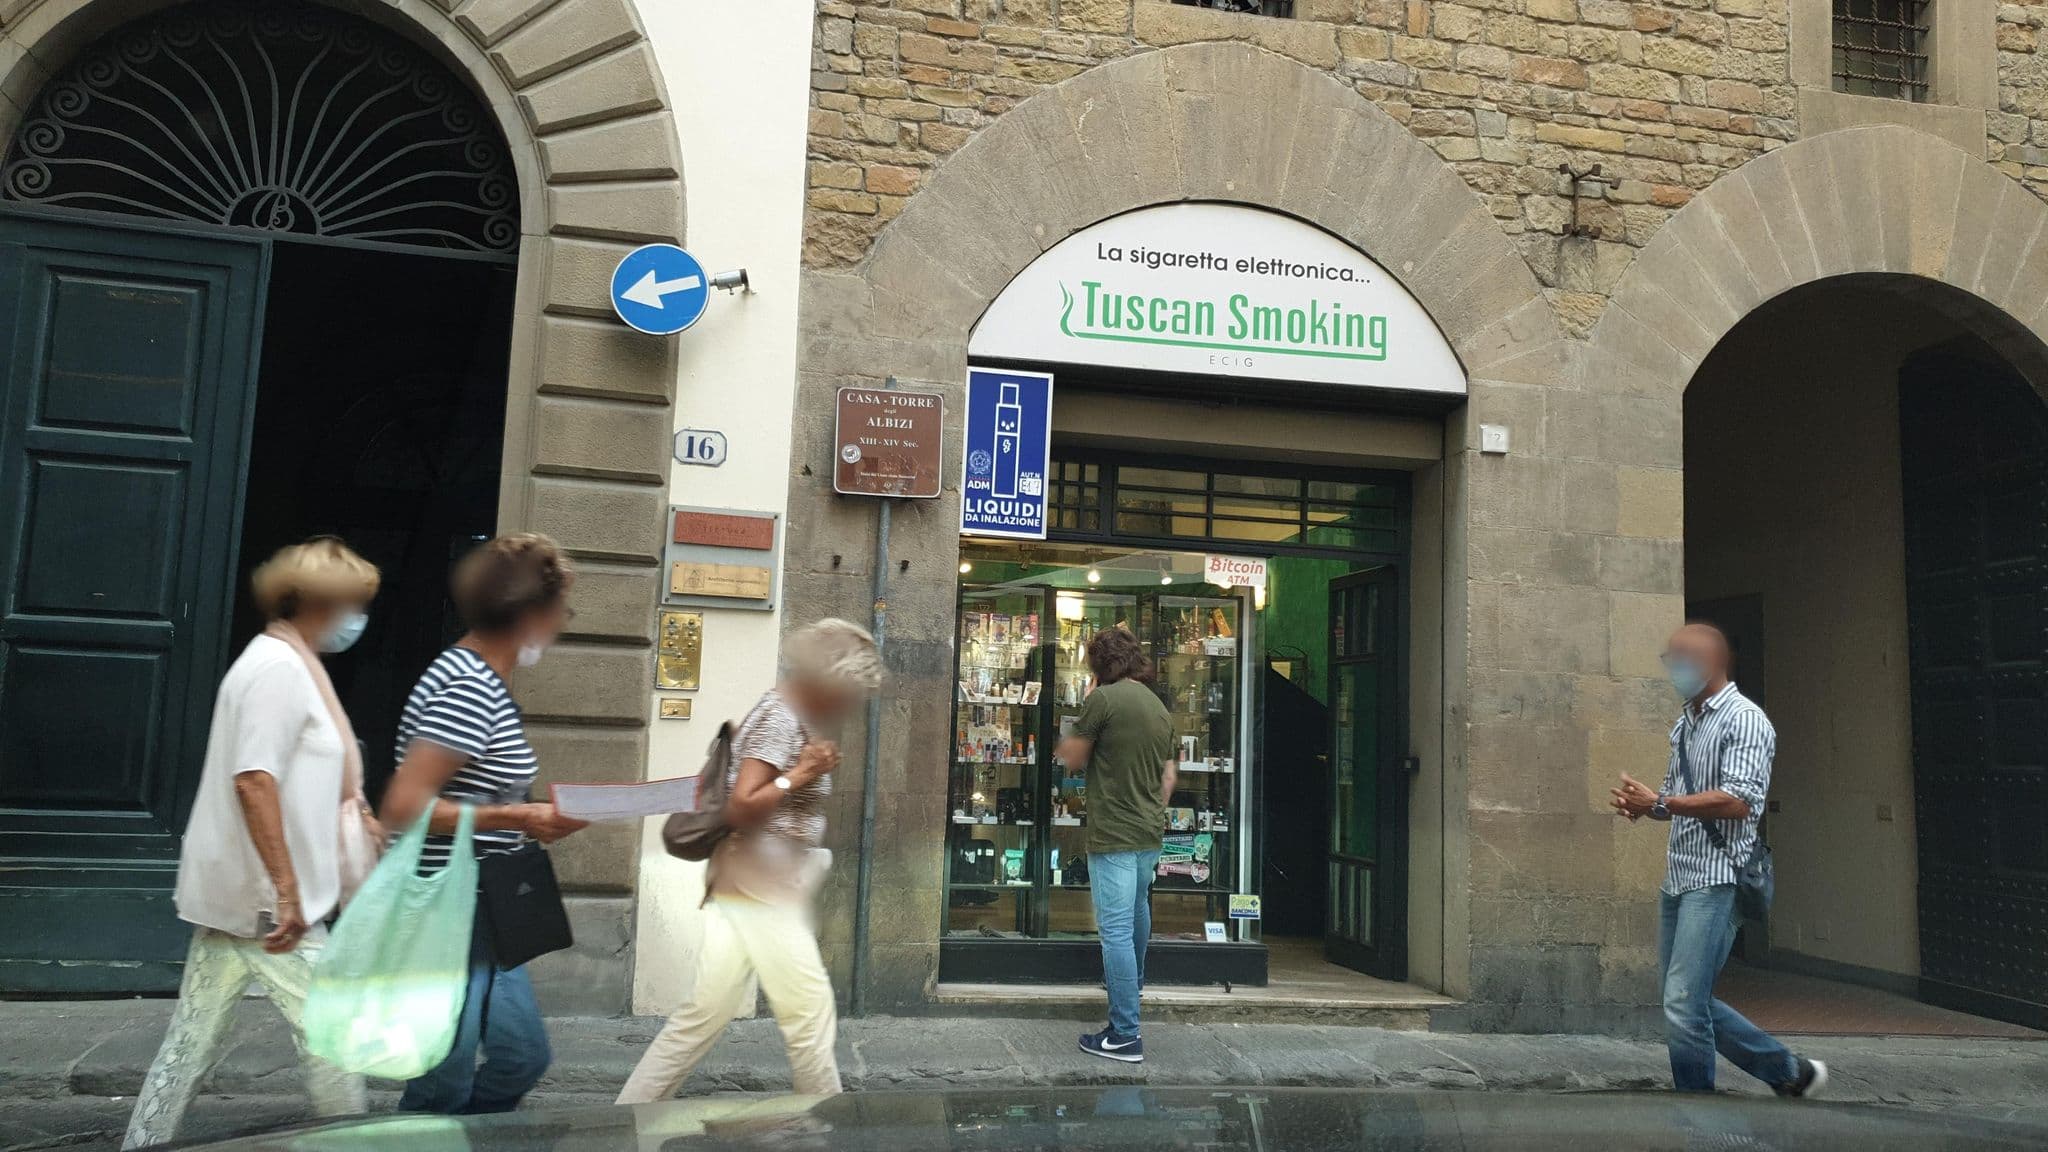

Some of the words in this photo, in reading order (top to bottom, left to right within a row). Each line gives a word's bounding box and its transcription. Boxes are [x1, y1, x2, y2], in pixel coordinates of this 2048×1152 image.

[1097, 243, 1122, 263] La
[1129, 247, 1229, 273] sigaretta
[1236, 256, 1371, 284] elettronica...
[1081, 281, 1215, 336] Tuscan
[1228, 293, 1387, 361] Smoking
[847, 392, 880, 405] CASA
[890, 396, 934, 408] TORRE
[866, 417, 913, 429] ALBIZI
[685, 436, 715, 461] 16
[903, 440, 919, 448] Sec.
[967, 480, 990, 490] ADM
[965, 498, 1042, 518] LIQUIDI
[965, 513, 979, 522] DA
[981, 514, 1041, 527] INALAZIONE
[1209, 556, 1264, 574] Bitcoin
[1228, 576, 1250, 585] ATM
[1208, 927, 1224, 935] VISA
